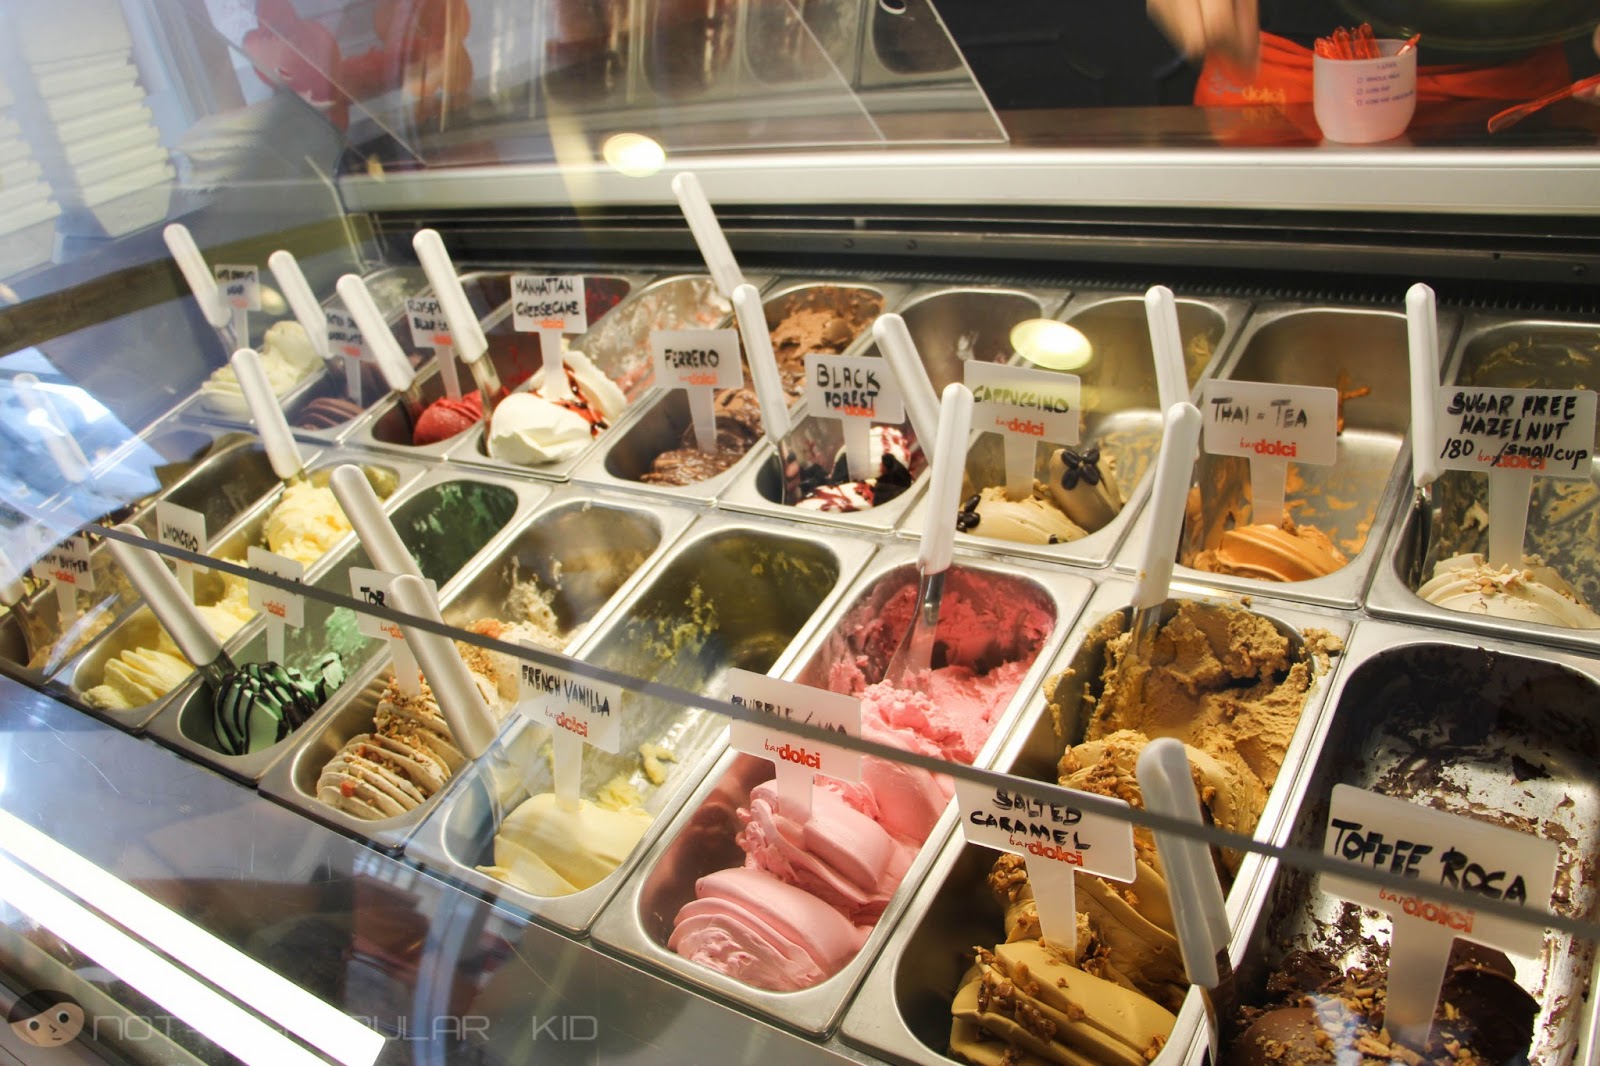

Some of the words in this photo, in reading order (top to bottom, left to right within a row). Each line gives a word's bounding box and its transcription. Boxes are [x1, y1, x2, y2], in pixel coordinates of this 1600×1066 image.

[516, 301, 580, 318] CHEESECAKE
[664, 348, 720, 369] FERRERO
[816, 363, 881, 391] BLACK
[824, 388, 879, 411] FOREST
[973, 384, 1070, 414] CAPPUCCINO
[1211, 397, 1250, 426] THAI
[1270, 399, 1308, 429] TEA
[1447, 391, 1515, 417] SUGAR
[1521, 394, 1578, 421] FREE
[522, 664, 561, 697] FRENCH
[563, 678, 610, 717] VANILLA
[992, 787, 1083, 826] SALTED
[969, 810, 1091, 851] CARAMEL
[1331, 818, 1433, 879] TOFFEE
[1440, 846, 1527, 907] ROCA
